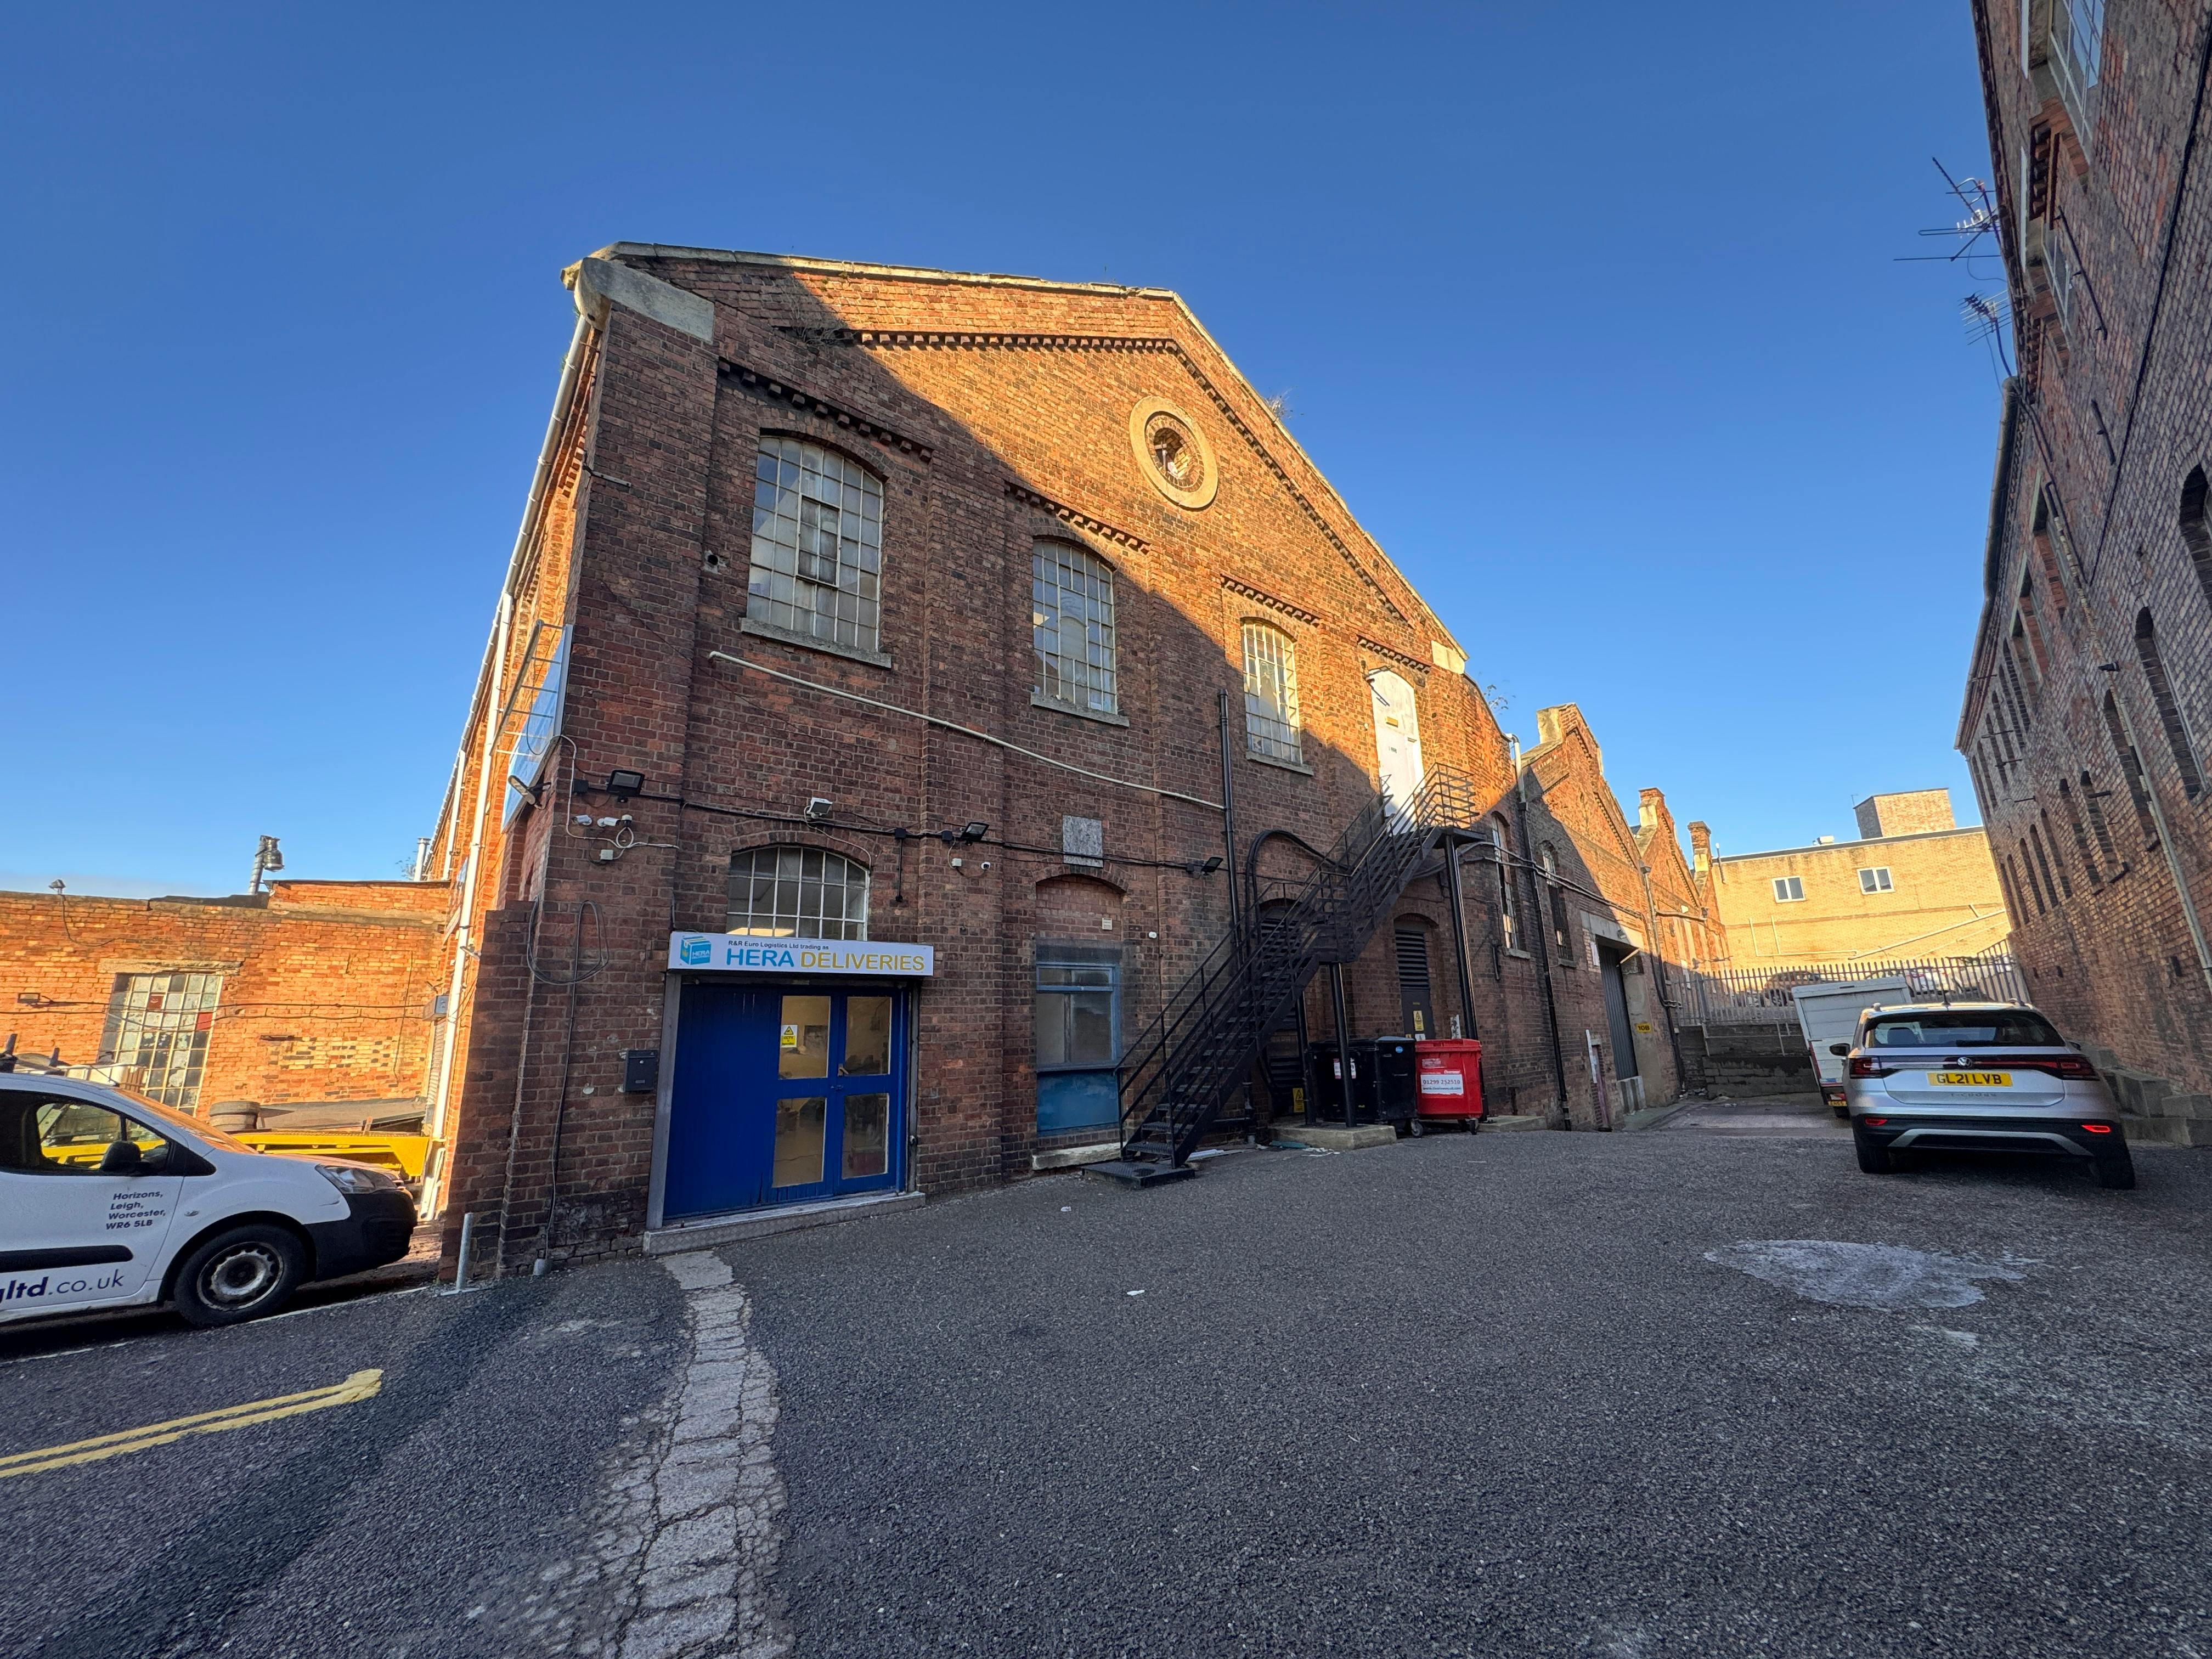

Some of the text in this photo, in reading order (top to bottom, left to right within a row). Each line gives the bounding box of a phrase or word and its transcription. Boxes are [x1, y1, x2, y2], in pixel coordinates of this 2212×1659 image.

[726, 948, 925, 971] HERA DELIVERIES
[1936, 1074, 2002, 1085] GL21 LVB
[113, 1191, 163, 1200] Horizons,
[110, 1201, 144, 1210] Leigh,
[109, 1210, 166, 1220] Worcester,
[106, 1221, 131, 1230] WR6
